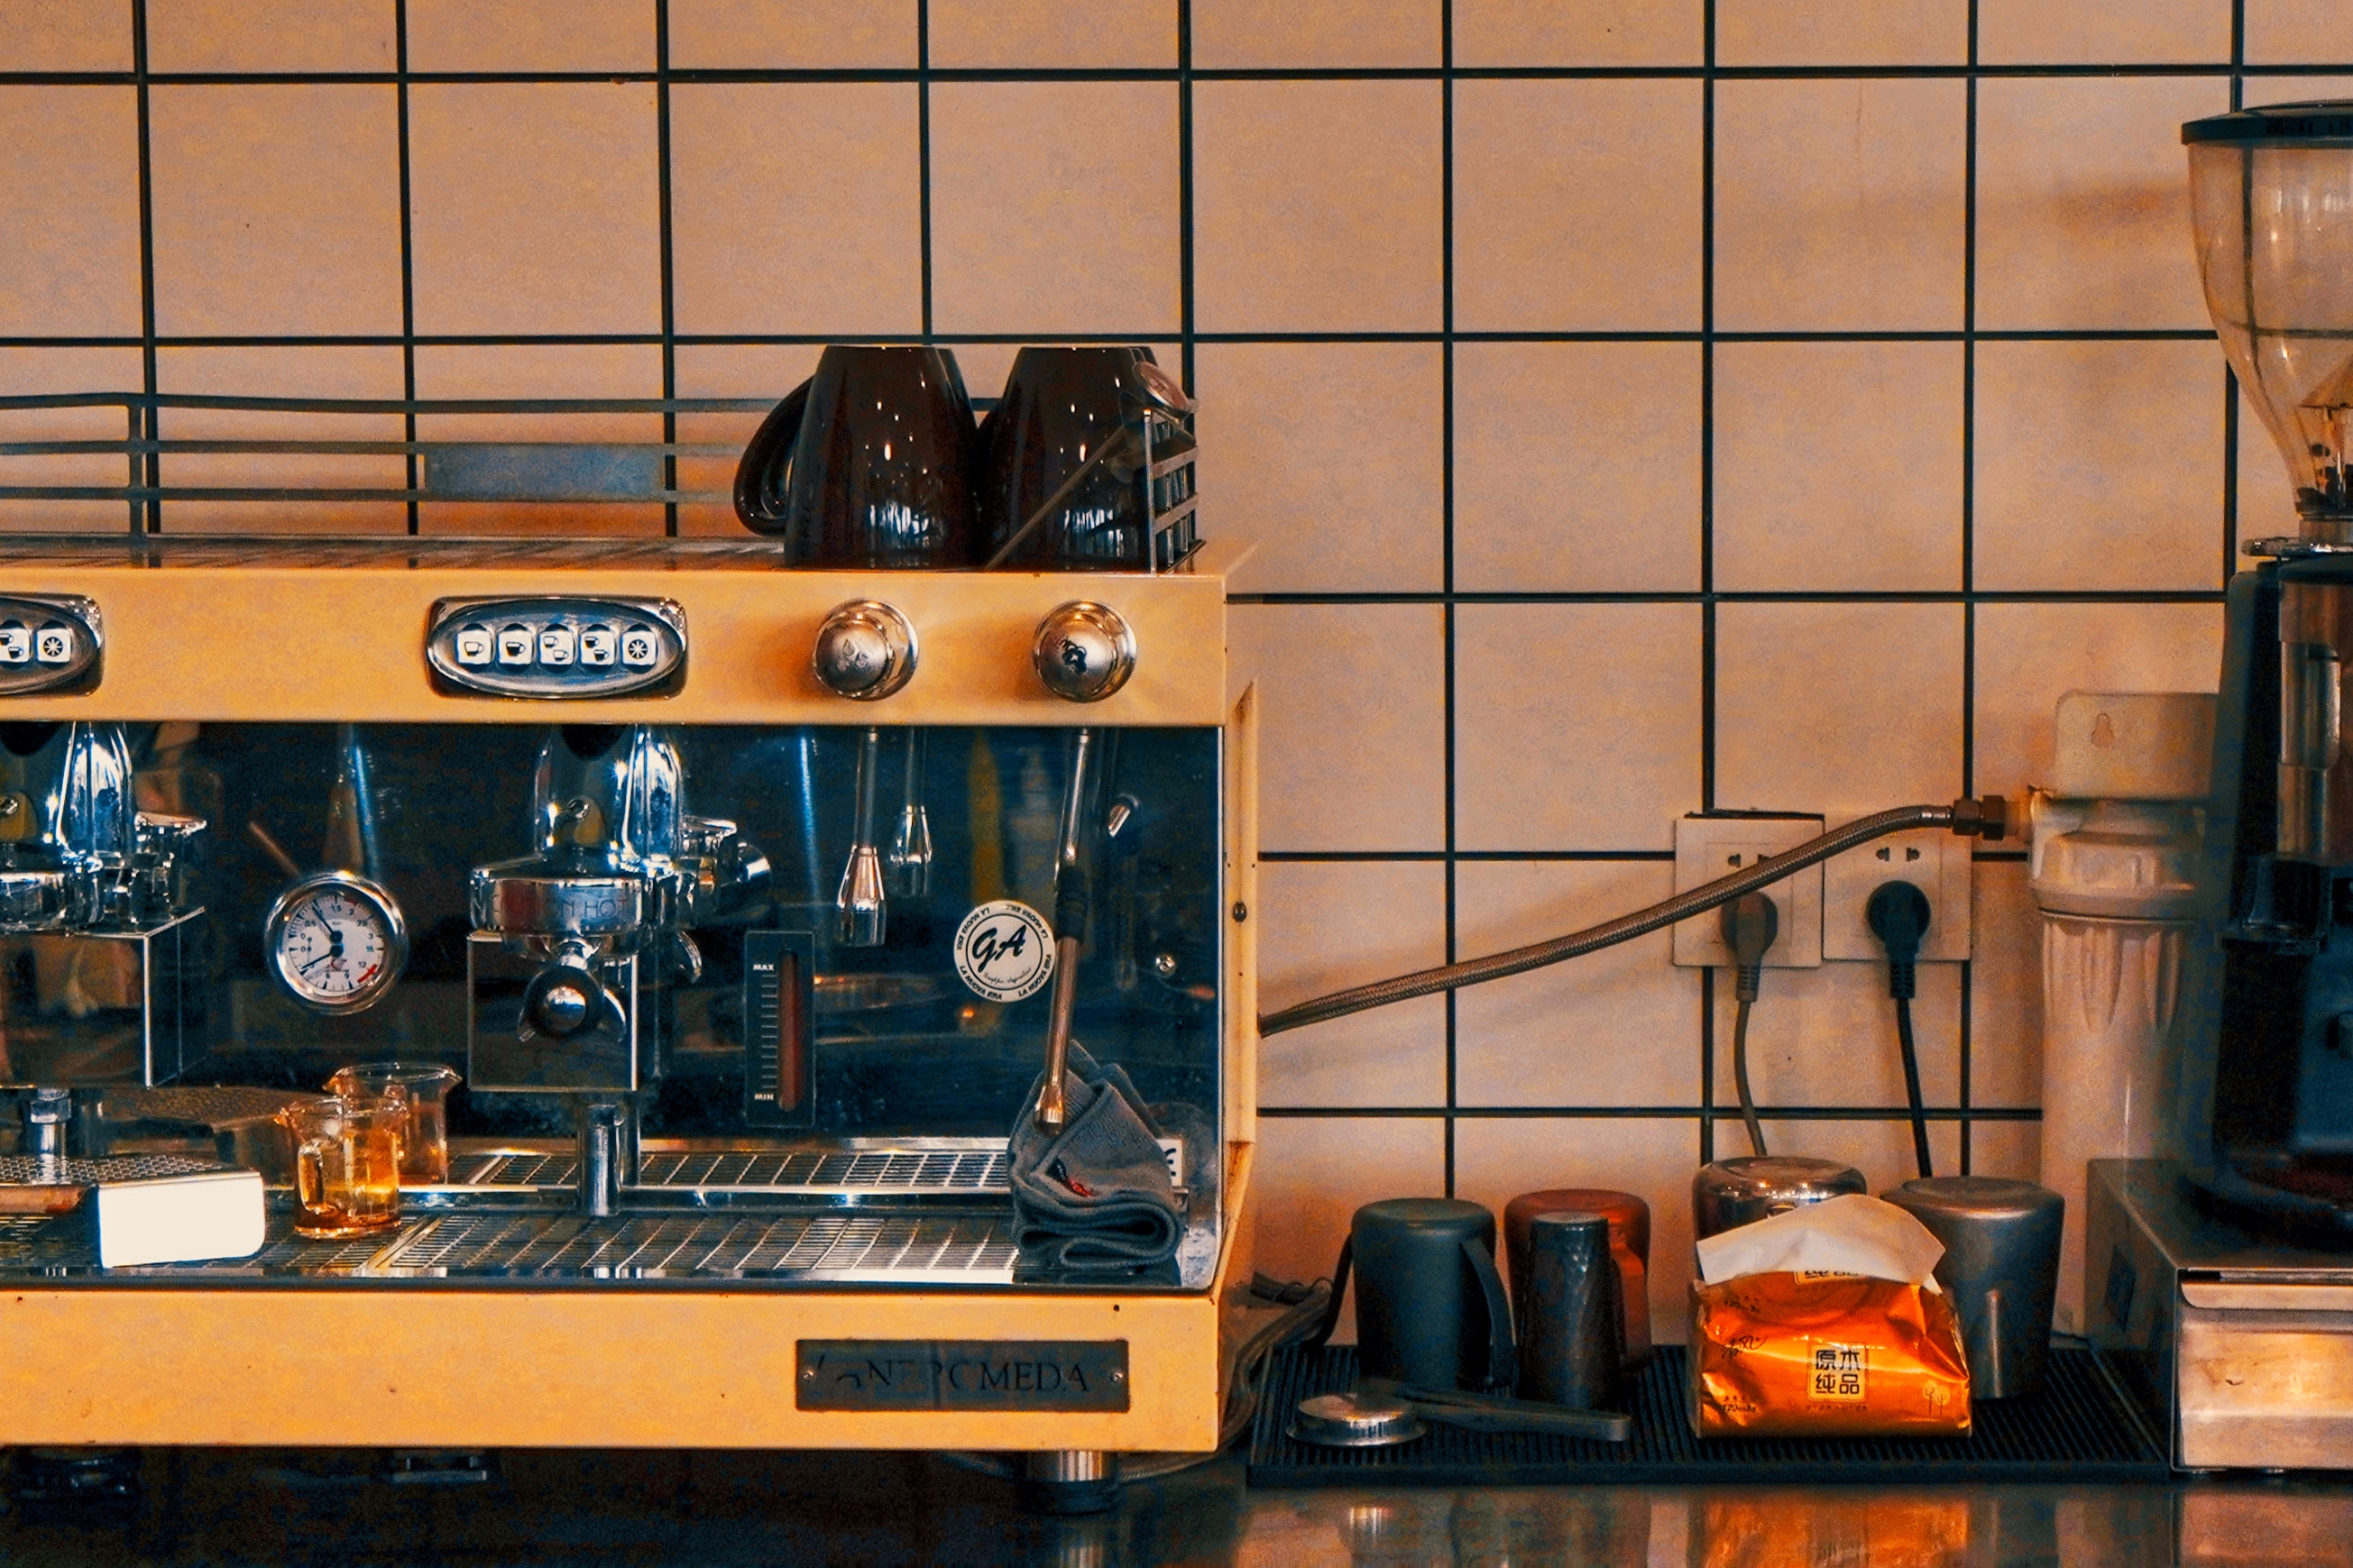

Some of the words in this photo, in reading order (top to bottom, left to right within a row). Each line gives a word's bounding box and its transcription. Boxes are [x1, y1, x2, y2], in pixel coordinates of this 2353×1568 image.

[972, 924, 1027, 973] GA
[960, 966, 968, 976] LA
[965, 975, 986, 995] NUOVA
[987, 992, 1003, 1000] ERA
[1018, 989, 1027, 997] LA
[1028, 969, 1047, 992] NUOVA
[1815, 1349, 1861, 1371] 原木
[1815, 1373, 1861, 1395] 纯品
